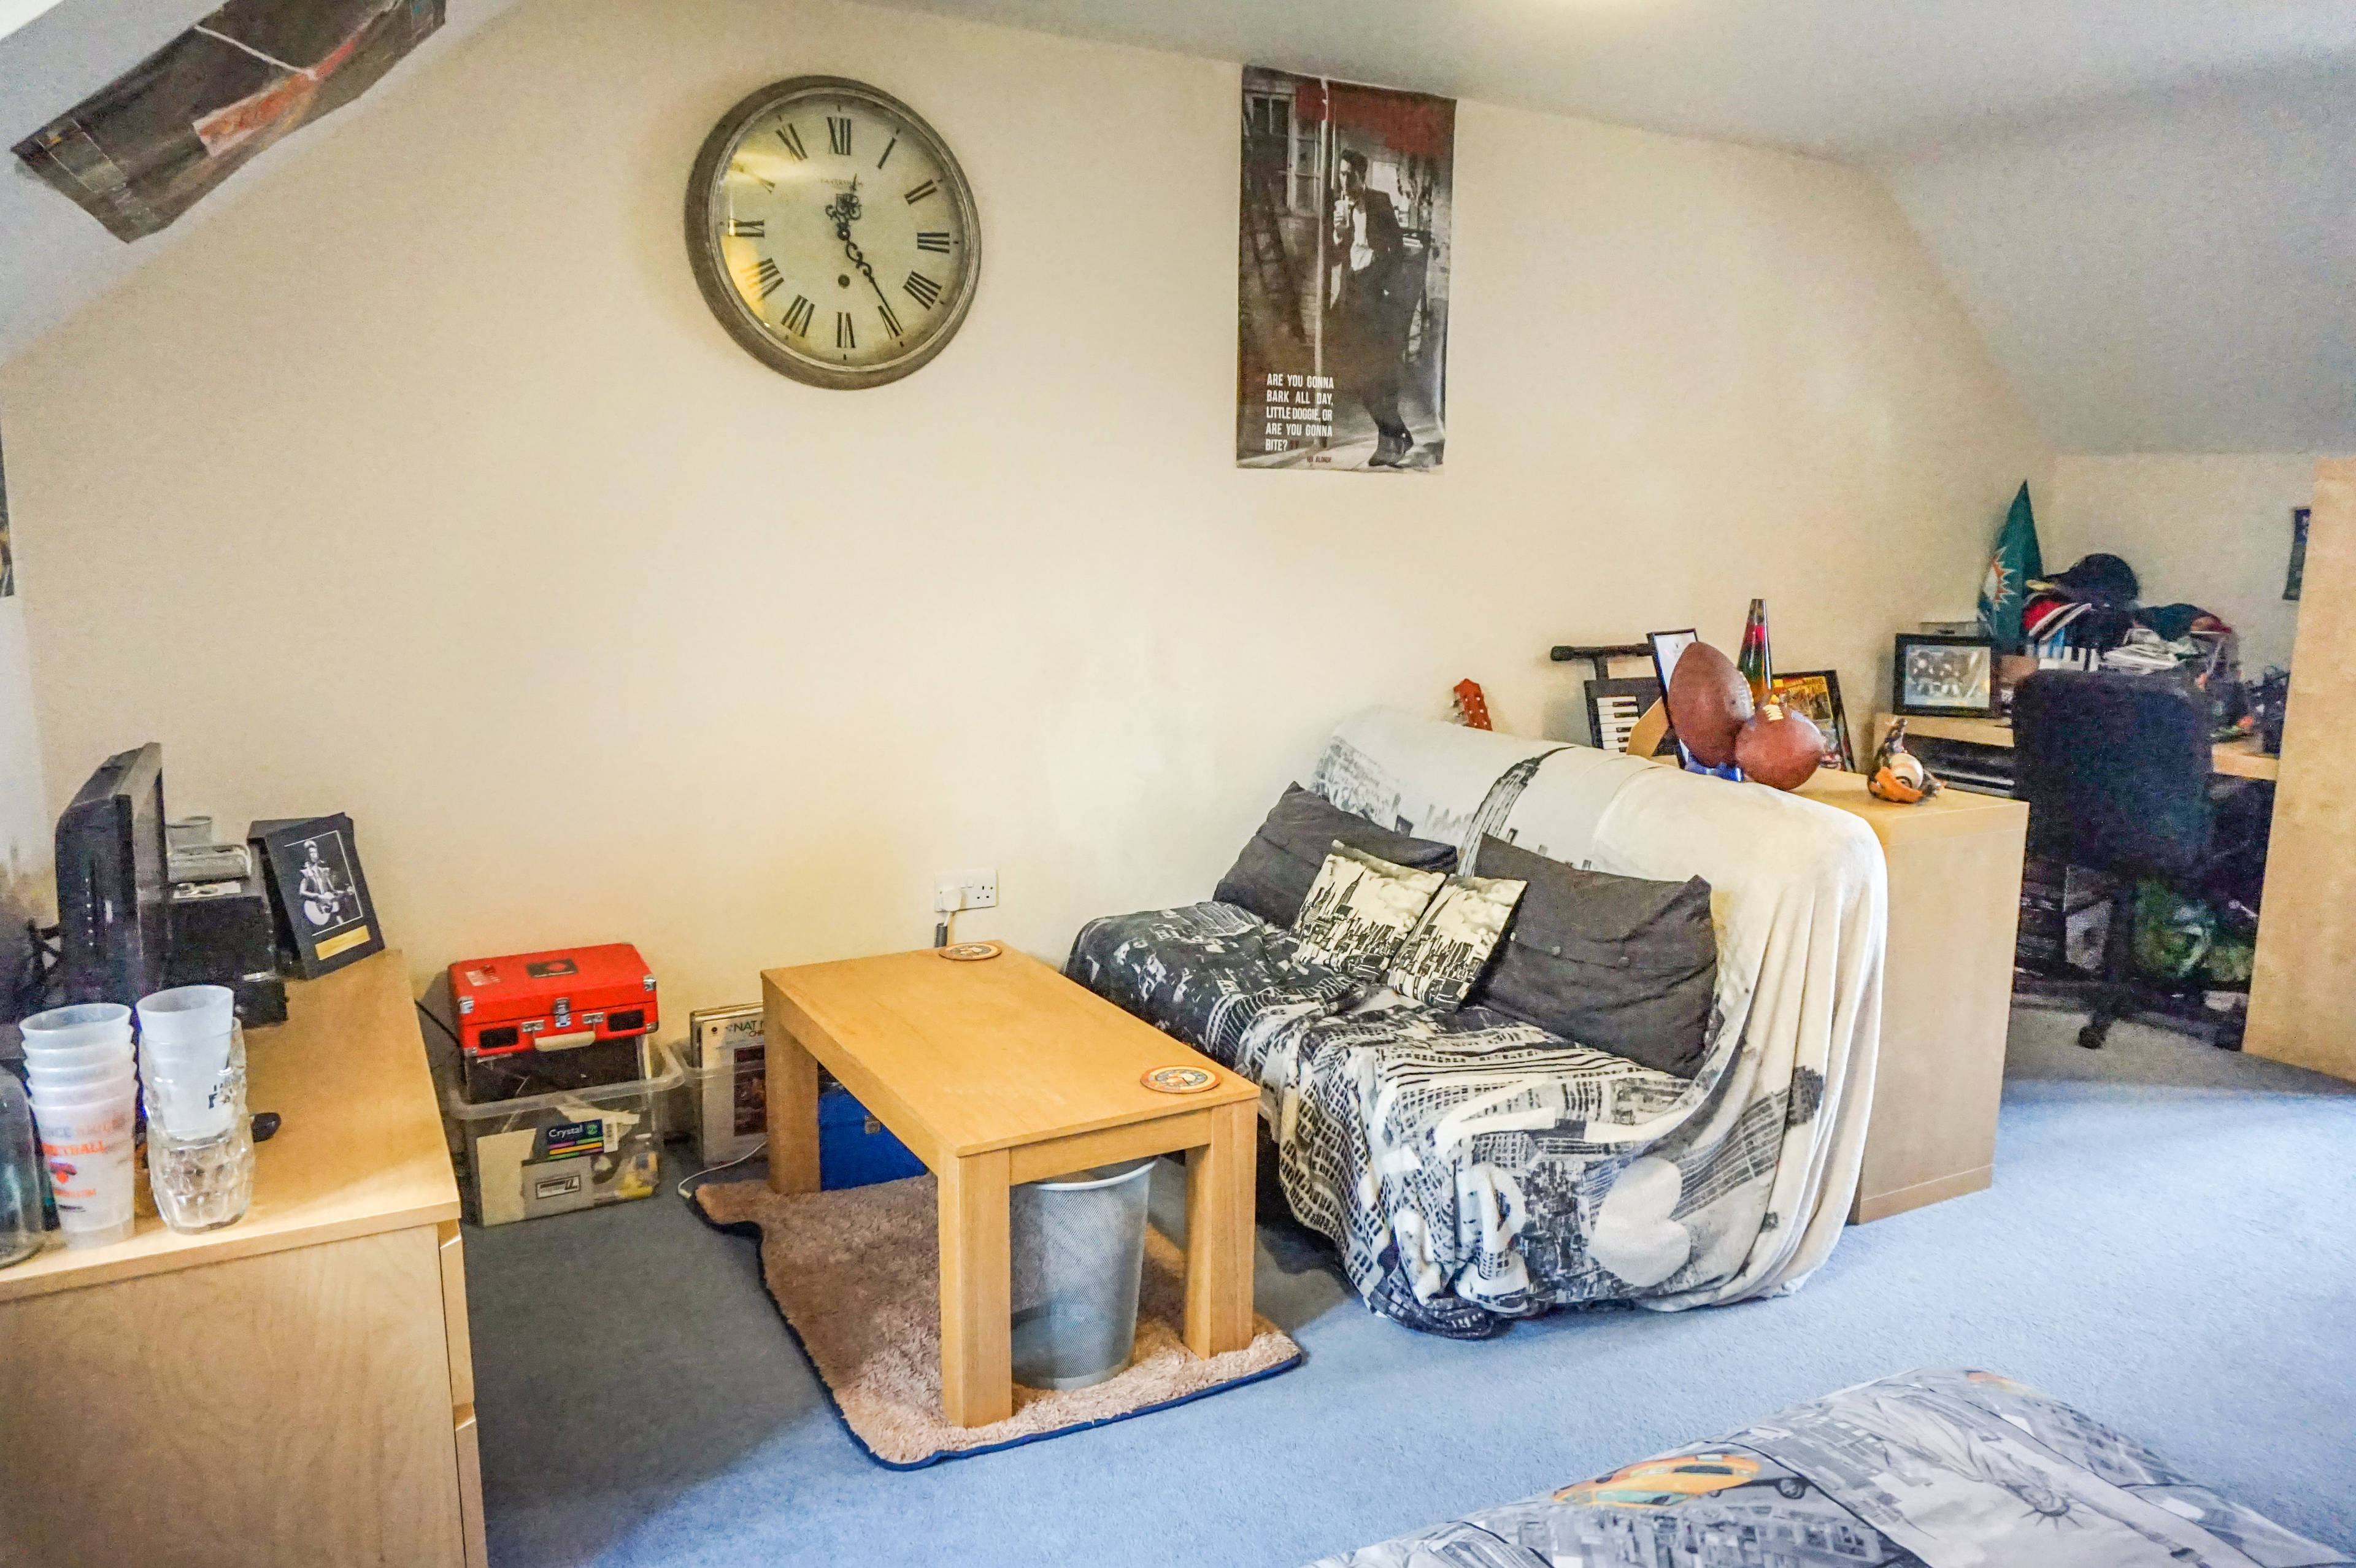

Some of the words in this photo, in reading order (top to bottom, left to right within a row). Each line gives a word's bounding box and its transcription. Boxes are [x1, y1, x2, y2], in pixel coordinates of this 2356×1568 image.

[776, 123, 809, 164] XI
[826, 117, 852, 156] XII
[876, 137, 897, 169] I
[904, 179, 937, 206] II
[728, 218, 765, 237] IX
[917, 232, 950, 254] III
[740, 257, 784, 301] VIII
[902, 269, 943, 311] IIII
[780, 294, 815, 338] VII
[836, 312, 856, 349] VI
[1267, 373, 1284, 386] ARE
[1287, 374, 1303, 387] YOU
[1306, 375, 1334, 389] GONNA
[1266, 389, 1290, 402] BARK
[1295, 391, 1311, 404] ALL
[1316, 392, 1333, 406] DAY,
[1266, 405, 1291, 419] LITTLE
[1292, 407, 1321, 422] DOGGIE,
[1322, 409, 1333, 421] OR
[1265, 422, 1282, 435] ARE
[1286, 423, 1302, 436] YOU
[1305, 424, 1333, 437] GONNA
[1265, 439, 1288, 452] BITE?
[734, 1020, 757, 1032] NAT
[549, 1125, 583, 1138] Crystal
